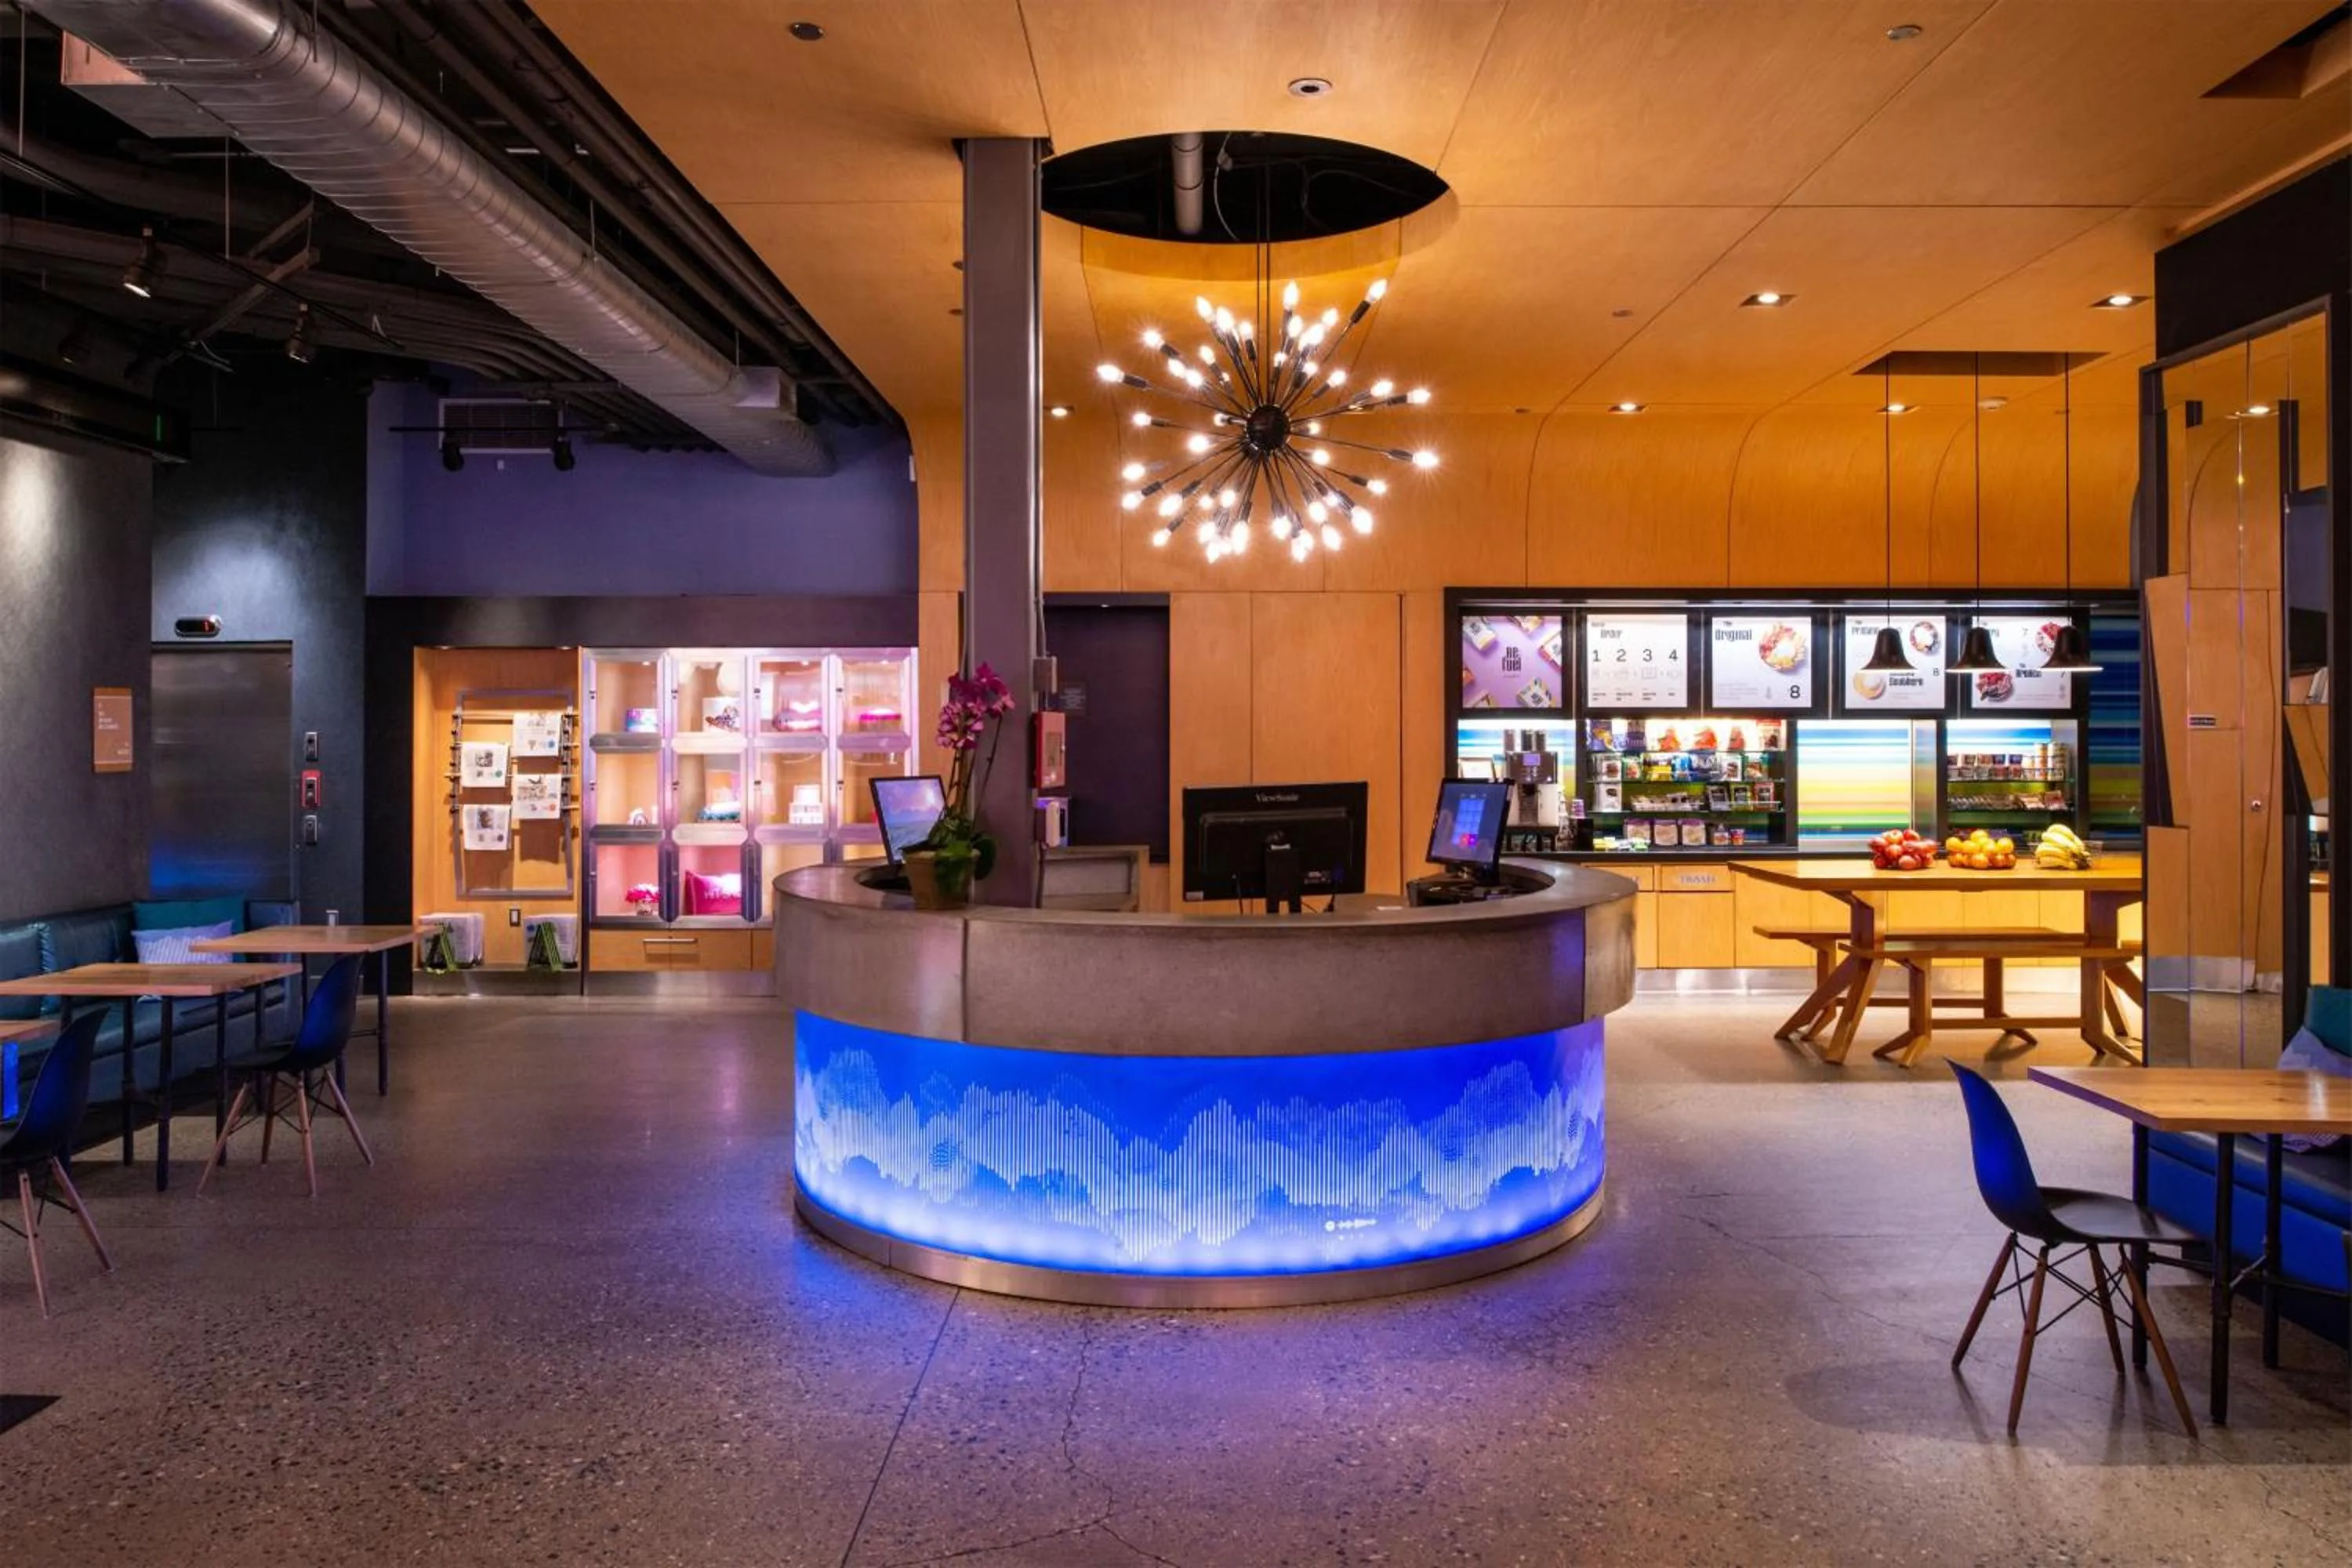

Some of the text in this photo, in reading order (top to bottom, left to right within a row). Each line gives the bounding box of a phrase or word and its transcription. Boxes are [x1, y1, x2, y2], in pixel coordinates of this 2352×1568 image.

[1715, 629, 1752, 641] Original
[1592, 648, 1679, 662] 1 2 3 4
[1790, 684, 1801, 699] 8
[1255, 791, 1300, 803] ViewSonic
[1679, 874, 1715, 884] TRASH
